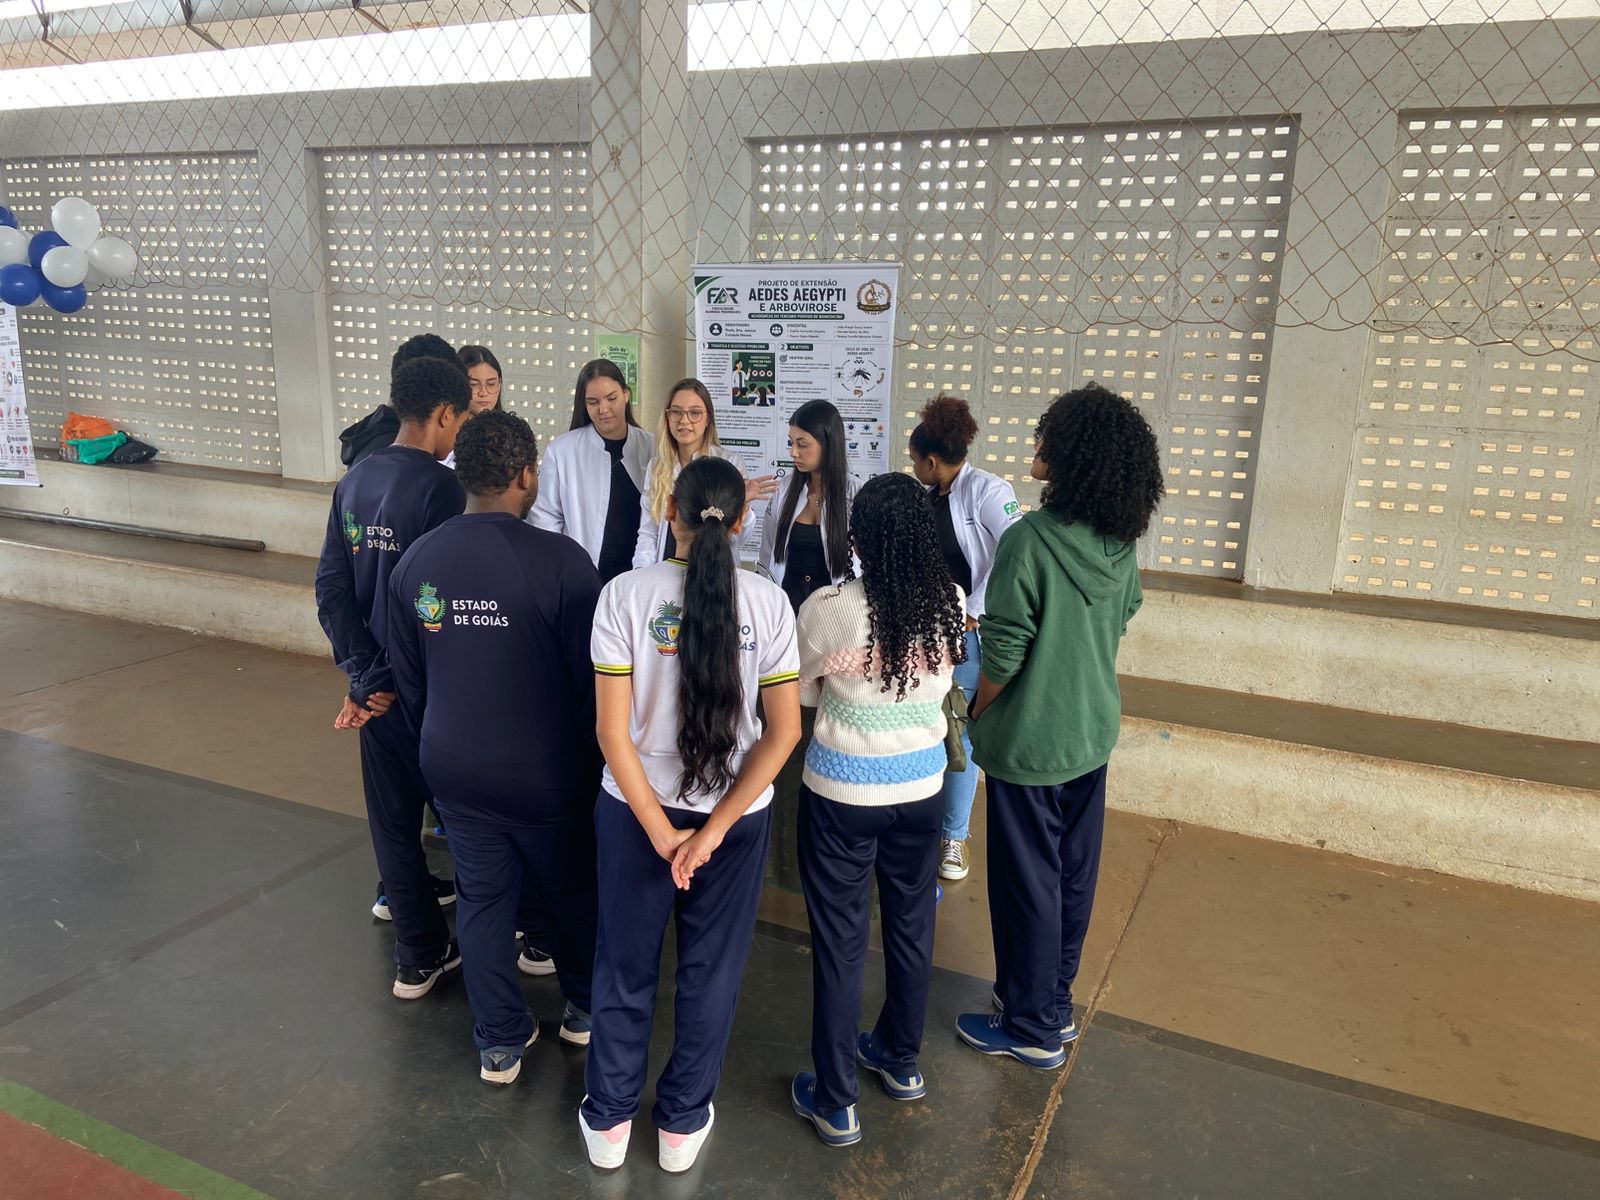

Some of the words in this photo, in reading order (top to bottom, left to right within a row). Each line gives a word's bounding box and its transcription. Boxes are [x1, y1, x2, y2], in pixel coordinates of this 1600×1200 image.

[707, 287, 738, 304] FAR
[748, 288, 788, 301] AEDES
[793, 288, 846, 301] AEGYPTI
[760, 303, 766, 311] E
[769, 303, 837, 312] ARBOVIROSE
[452, 600, 498, 611] ESTADO
[454, 615, 469, 625] DE
[472, 613, 509, 627] GOIÁS
